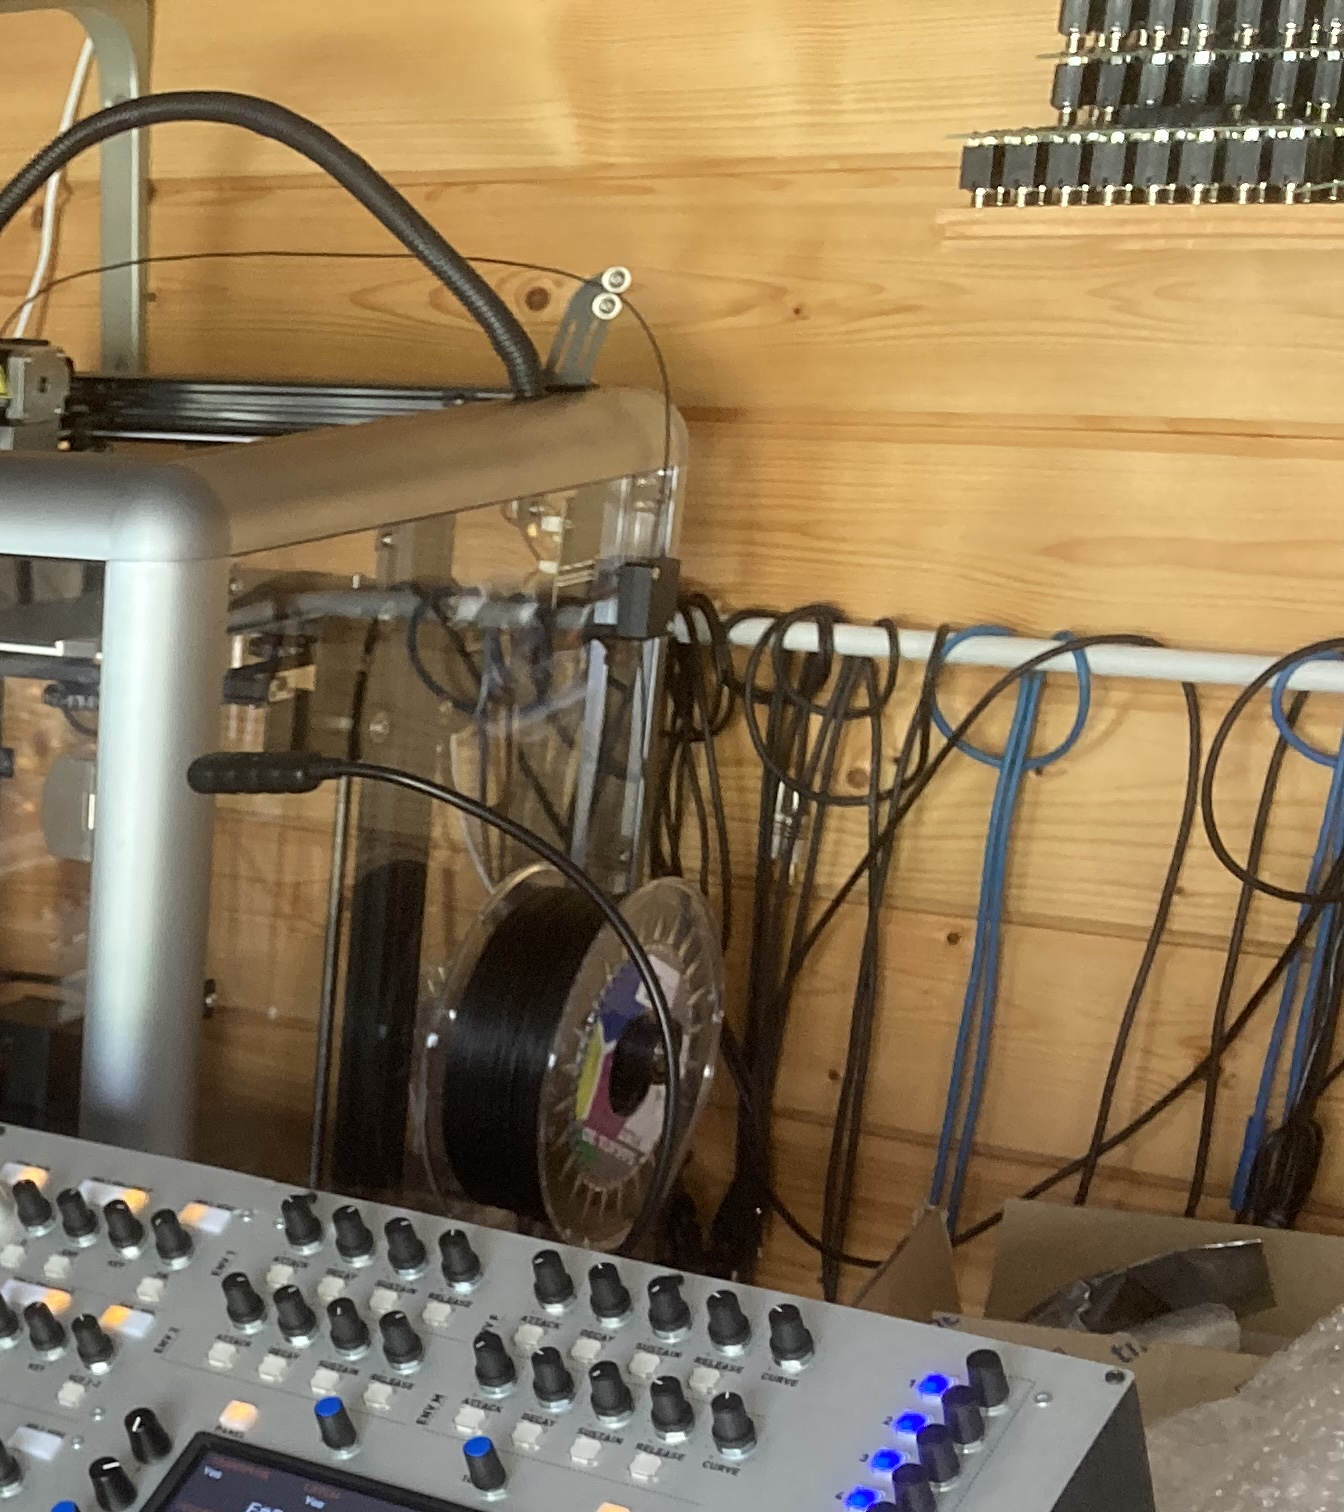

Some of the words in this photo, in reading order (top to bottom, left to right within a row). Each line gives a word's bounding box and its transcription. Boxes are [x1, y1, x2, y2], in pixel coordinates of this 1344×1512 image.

[520, 1314, 563, 1330] ATTACK
[580, 1328, 617, 1343] DECAY
[635, 1341, 684, 1359] SUSTAIN
[693, 1356, 744, 1375] RELEASE
[370, 1373, 415, 1390] RELEASE
[761, 1372, 799, 1387] CURVE
[462, 1398, 504, 1413] ATTACK
[521, 1412, 556, 1427] DECAY
[577, 1427, 624, 1445] SUSTAIN
[635, 1442, 686, 1462] RELEASE
[702, 1460, 740, 1477] CURVE
